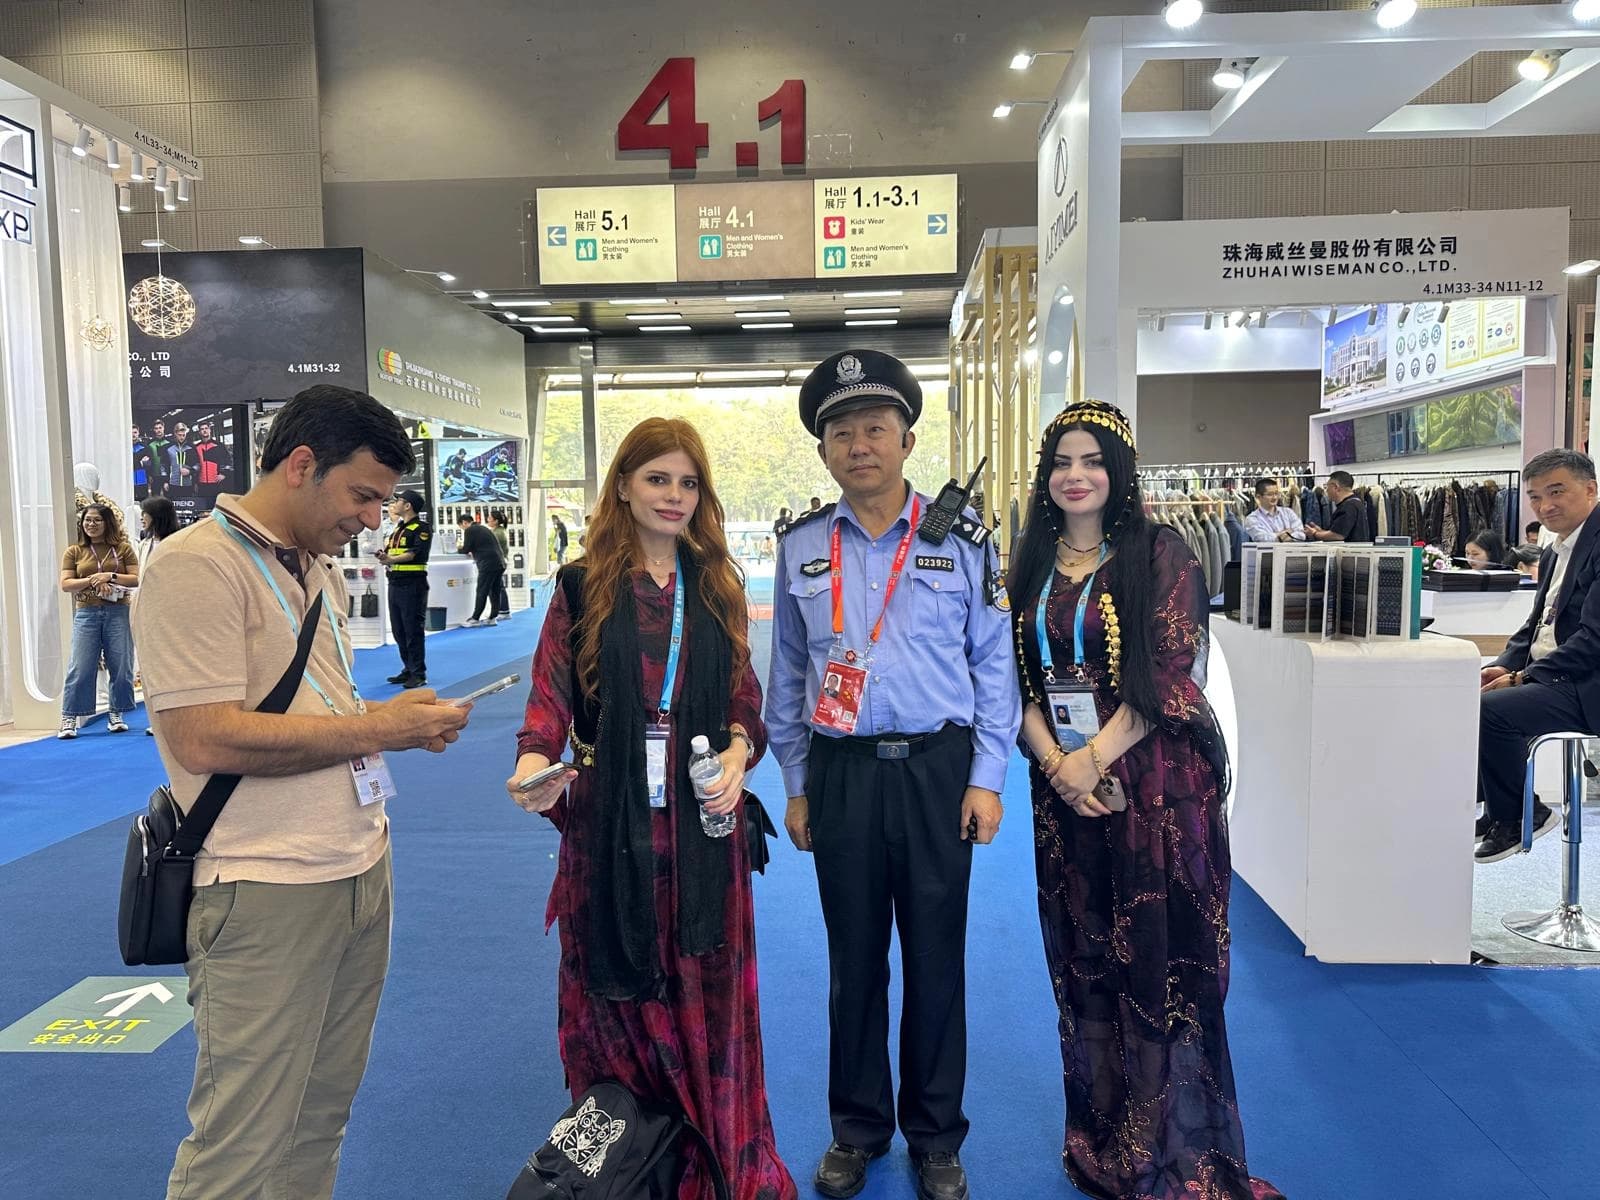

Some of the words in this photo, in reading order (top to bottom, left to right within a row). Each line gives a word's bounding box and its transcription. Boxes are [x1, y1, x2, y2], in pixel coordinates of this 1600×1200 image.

[617, 57, 807, 169] 4.1
[824, 187, 847, 197] Hall
[852, 185, 919, 208] 1.1-3.1
[825, 198, 847, 209] 展厅
[574, 210, 596, 220] Hall
[601, 210, 629, 231] 5.1
[699, 206, 721, 217] Hall
[725, 206, 754, 228] 4.1
[867, 217, 885, 225] Wear
[575, 221, 597, 232] 展厅
[699, 217, 721, 229] 展厅
[629, 236, 658, 244] Women's
[754, 233, 783, 241] Women's
[601, 246, 629, 254] Clothing
[726, 242, 754, 250] Clothing
[879, 243, 909, 251] Women's
[1222, 236, 1458, 263] 珠海威丝曼股份有限公司
[850, 252, 878, 261] Clothing
[1222, 265, 1288, 279] ZHUHAI
[1291, 262, 1376, 277] WISEMAN
[151, 351, 170, 361] LTD
[287, 363, 340, 373] 4.1M31-32
[918, 559, 953, 569] 023922
[44, 1019, 151, 1031] EXIT
[28, 1033, 127, 1045] 安全出口
